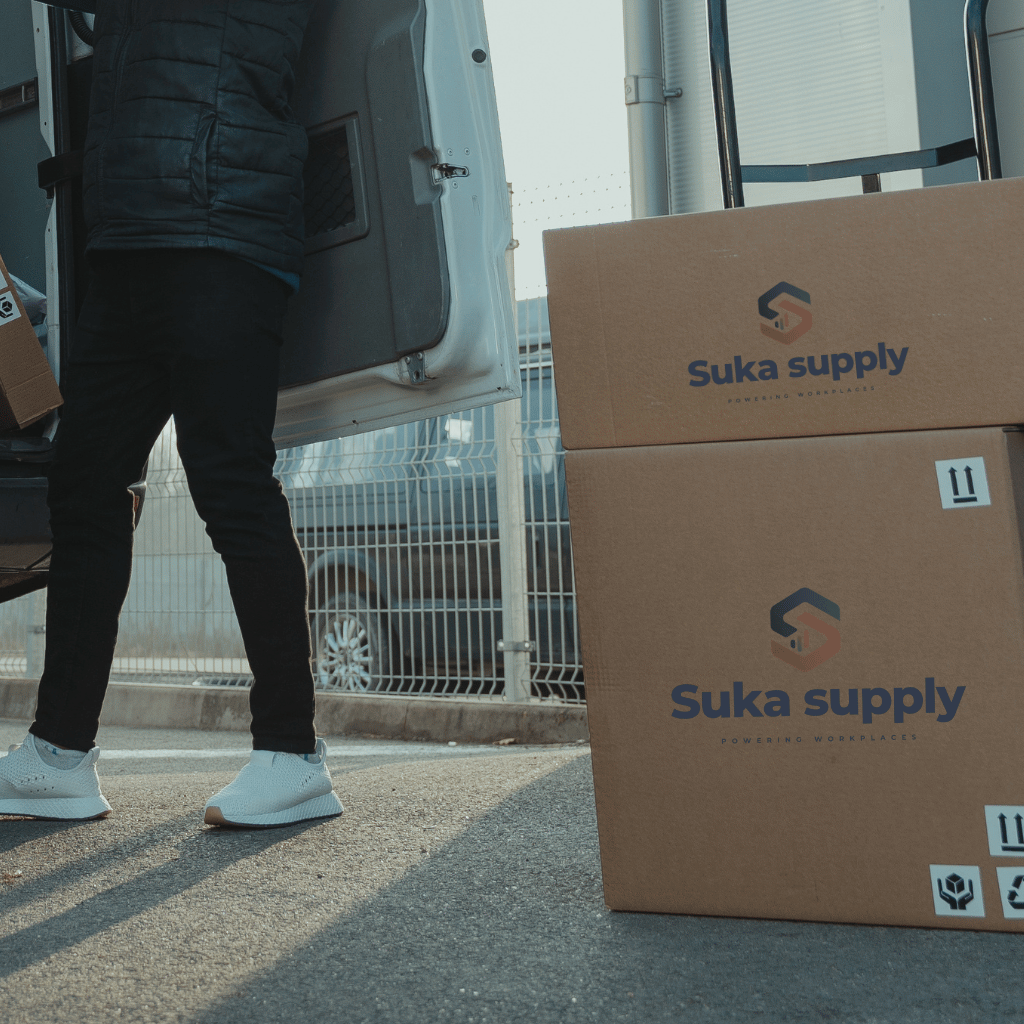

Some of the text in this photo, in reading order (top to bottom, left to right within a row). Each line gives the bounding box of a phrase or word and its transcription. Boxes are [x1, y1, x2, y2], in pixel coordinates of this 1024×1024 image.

[687, 342, 910, 387] Suka supply
[727, 385, 875, 403] POWERING WORKPLACES
[670, 677, 967, 724] Suka supply
[721, 733, 917, 745] POWERING WORKPLACES
